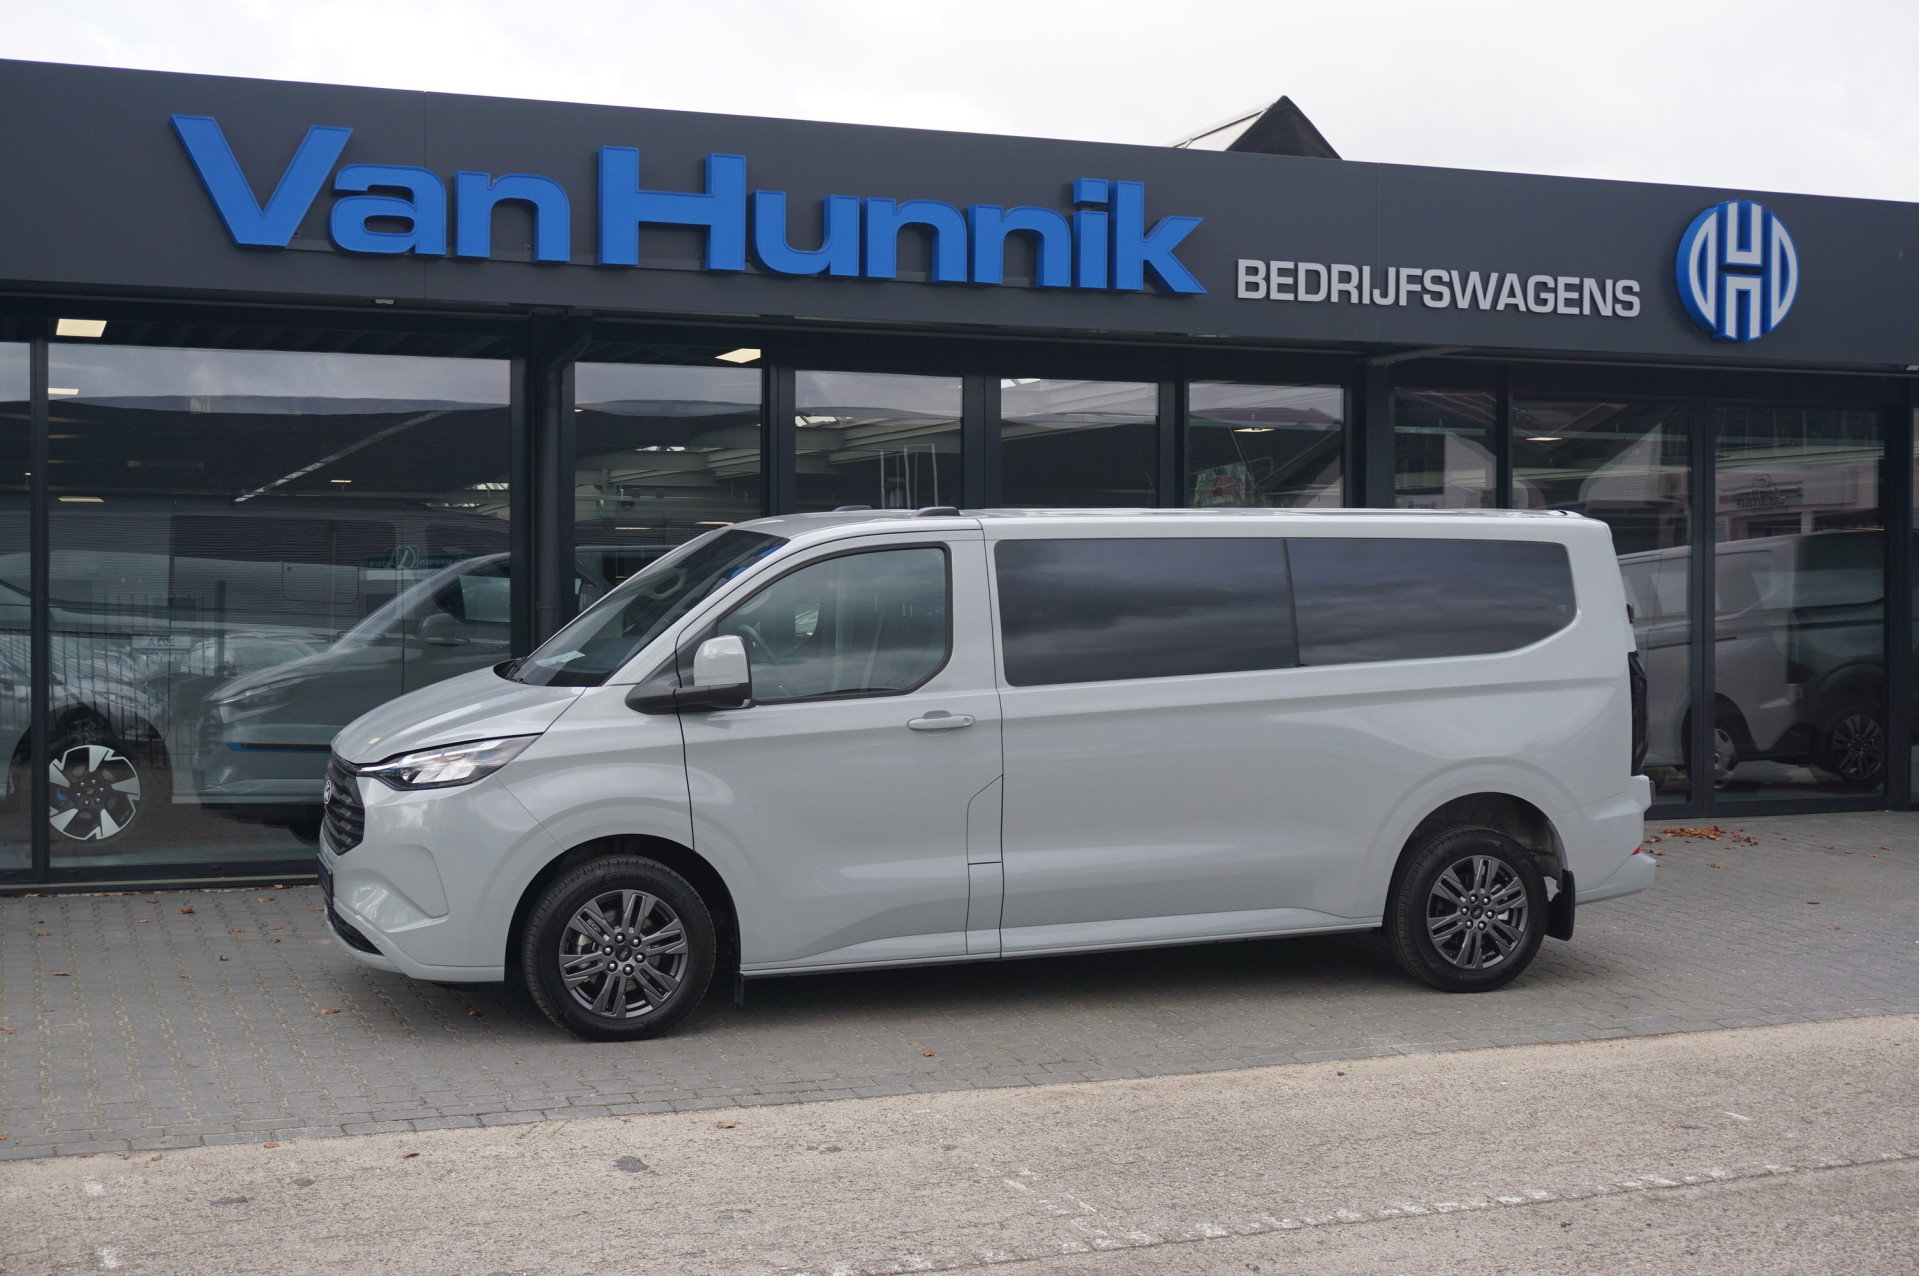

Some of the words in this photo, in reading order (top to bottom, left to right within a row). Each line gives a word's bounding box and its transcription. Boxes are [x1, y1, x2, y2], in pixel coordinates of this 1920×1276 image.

[170, 113, 571, 263] Van
[598, 144, 1207, 294] Hunnik
[1237, 258, 1641, 317] BEDRIJFSWAGENS
